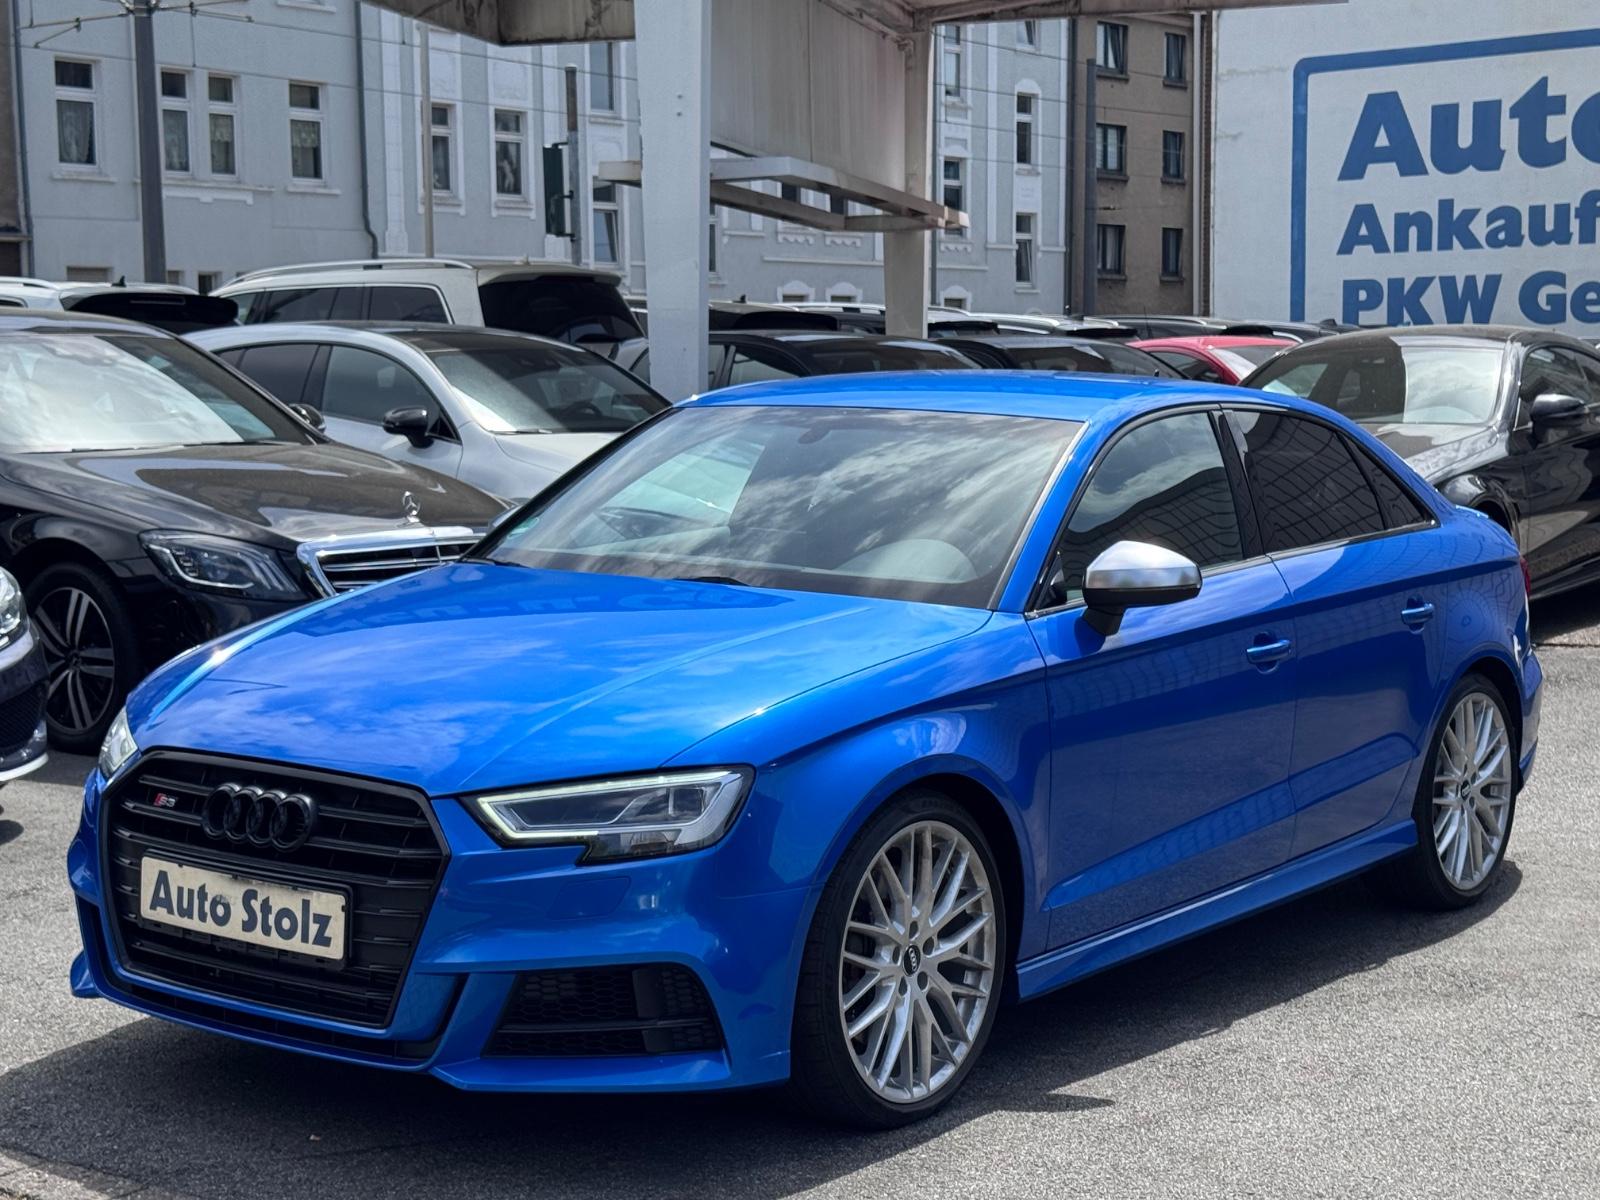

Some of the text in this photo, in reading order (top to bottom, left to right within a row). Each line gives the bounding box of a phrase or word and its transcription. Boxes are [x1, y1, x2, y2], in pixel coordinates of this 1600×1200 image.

[1336, 189, 1600, 256] Ankauf
[1342, 270, 1600, 327] PKW Ge
[149, 870, 333, 948] Auto Stolz
